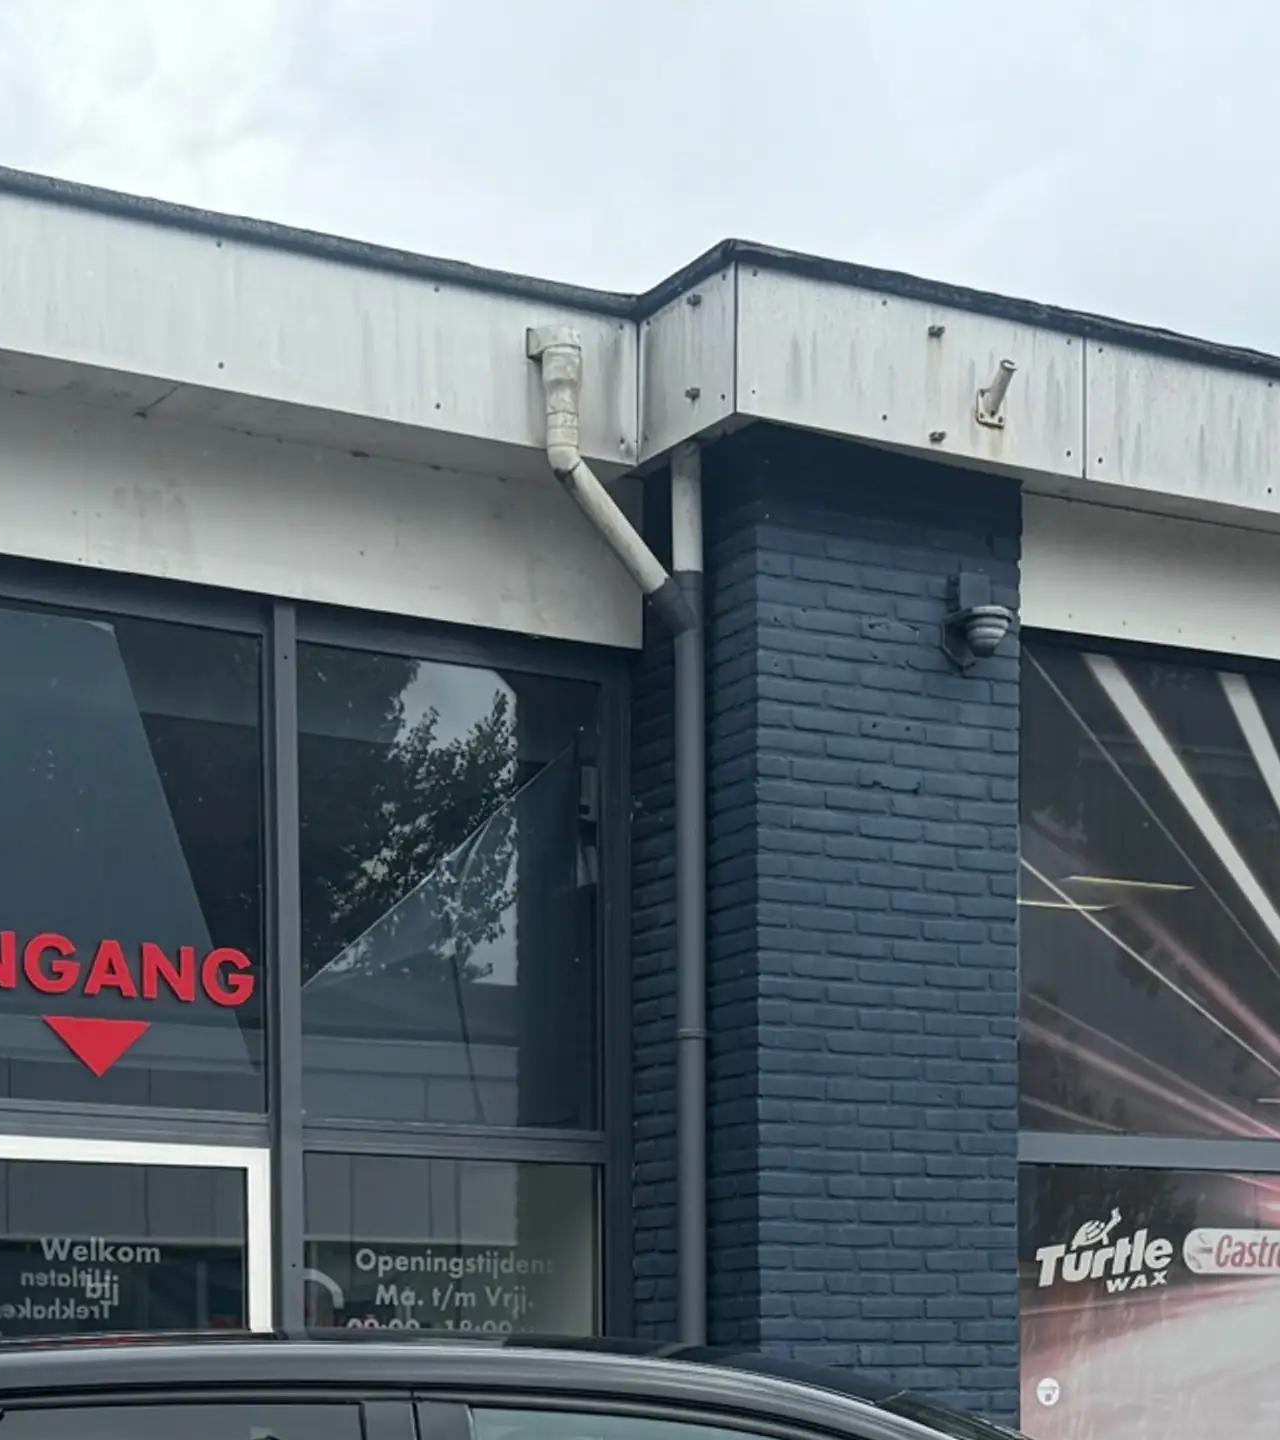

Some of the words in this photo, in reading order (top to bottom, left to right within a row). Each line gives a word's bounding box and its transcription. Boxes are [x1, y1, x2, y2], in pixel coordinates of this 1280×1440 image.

[40, 1236, 161, 1264] Welkom
[355, 1248, 553, 1280] Openingstijden:
[1035, 1229, 1173, 1287] Turtle
[1106, 1269, 1169, 1294] WAX
[375, 1283, 424, 1308] Ma.
[431, 1282, 477, 1312] t/m
